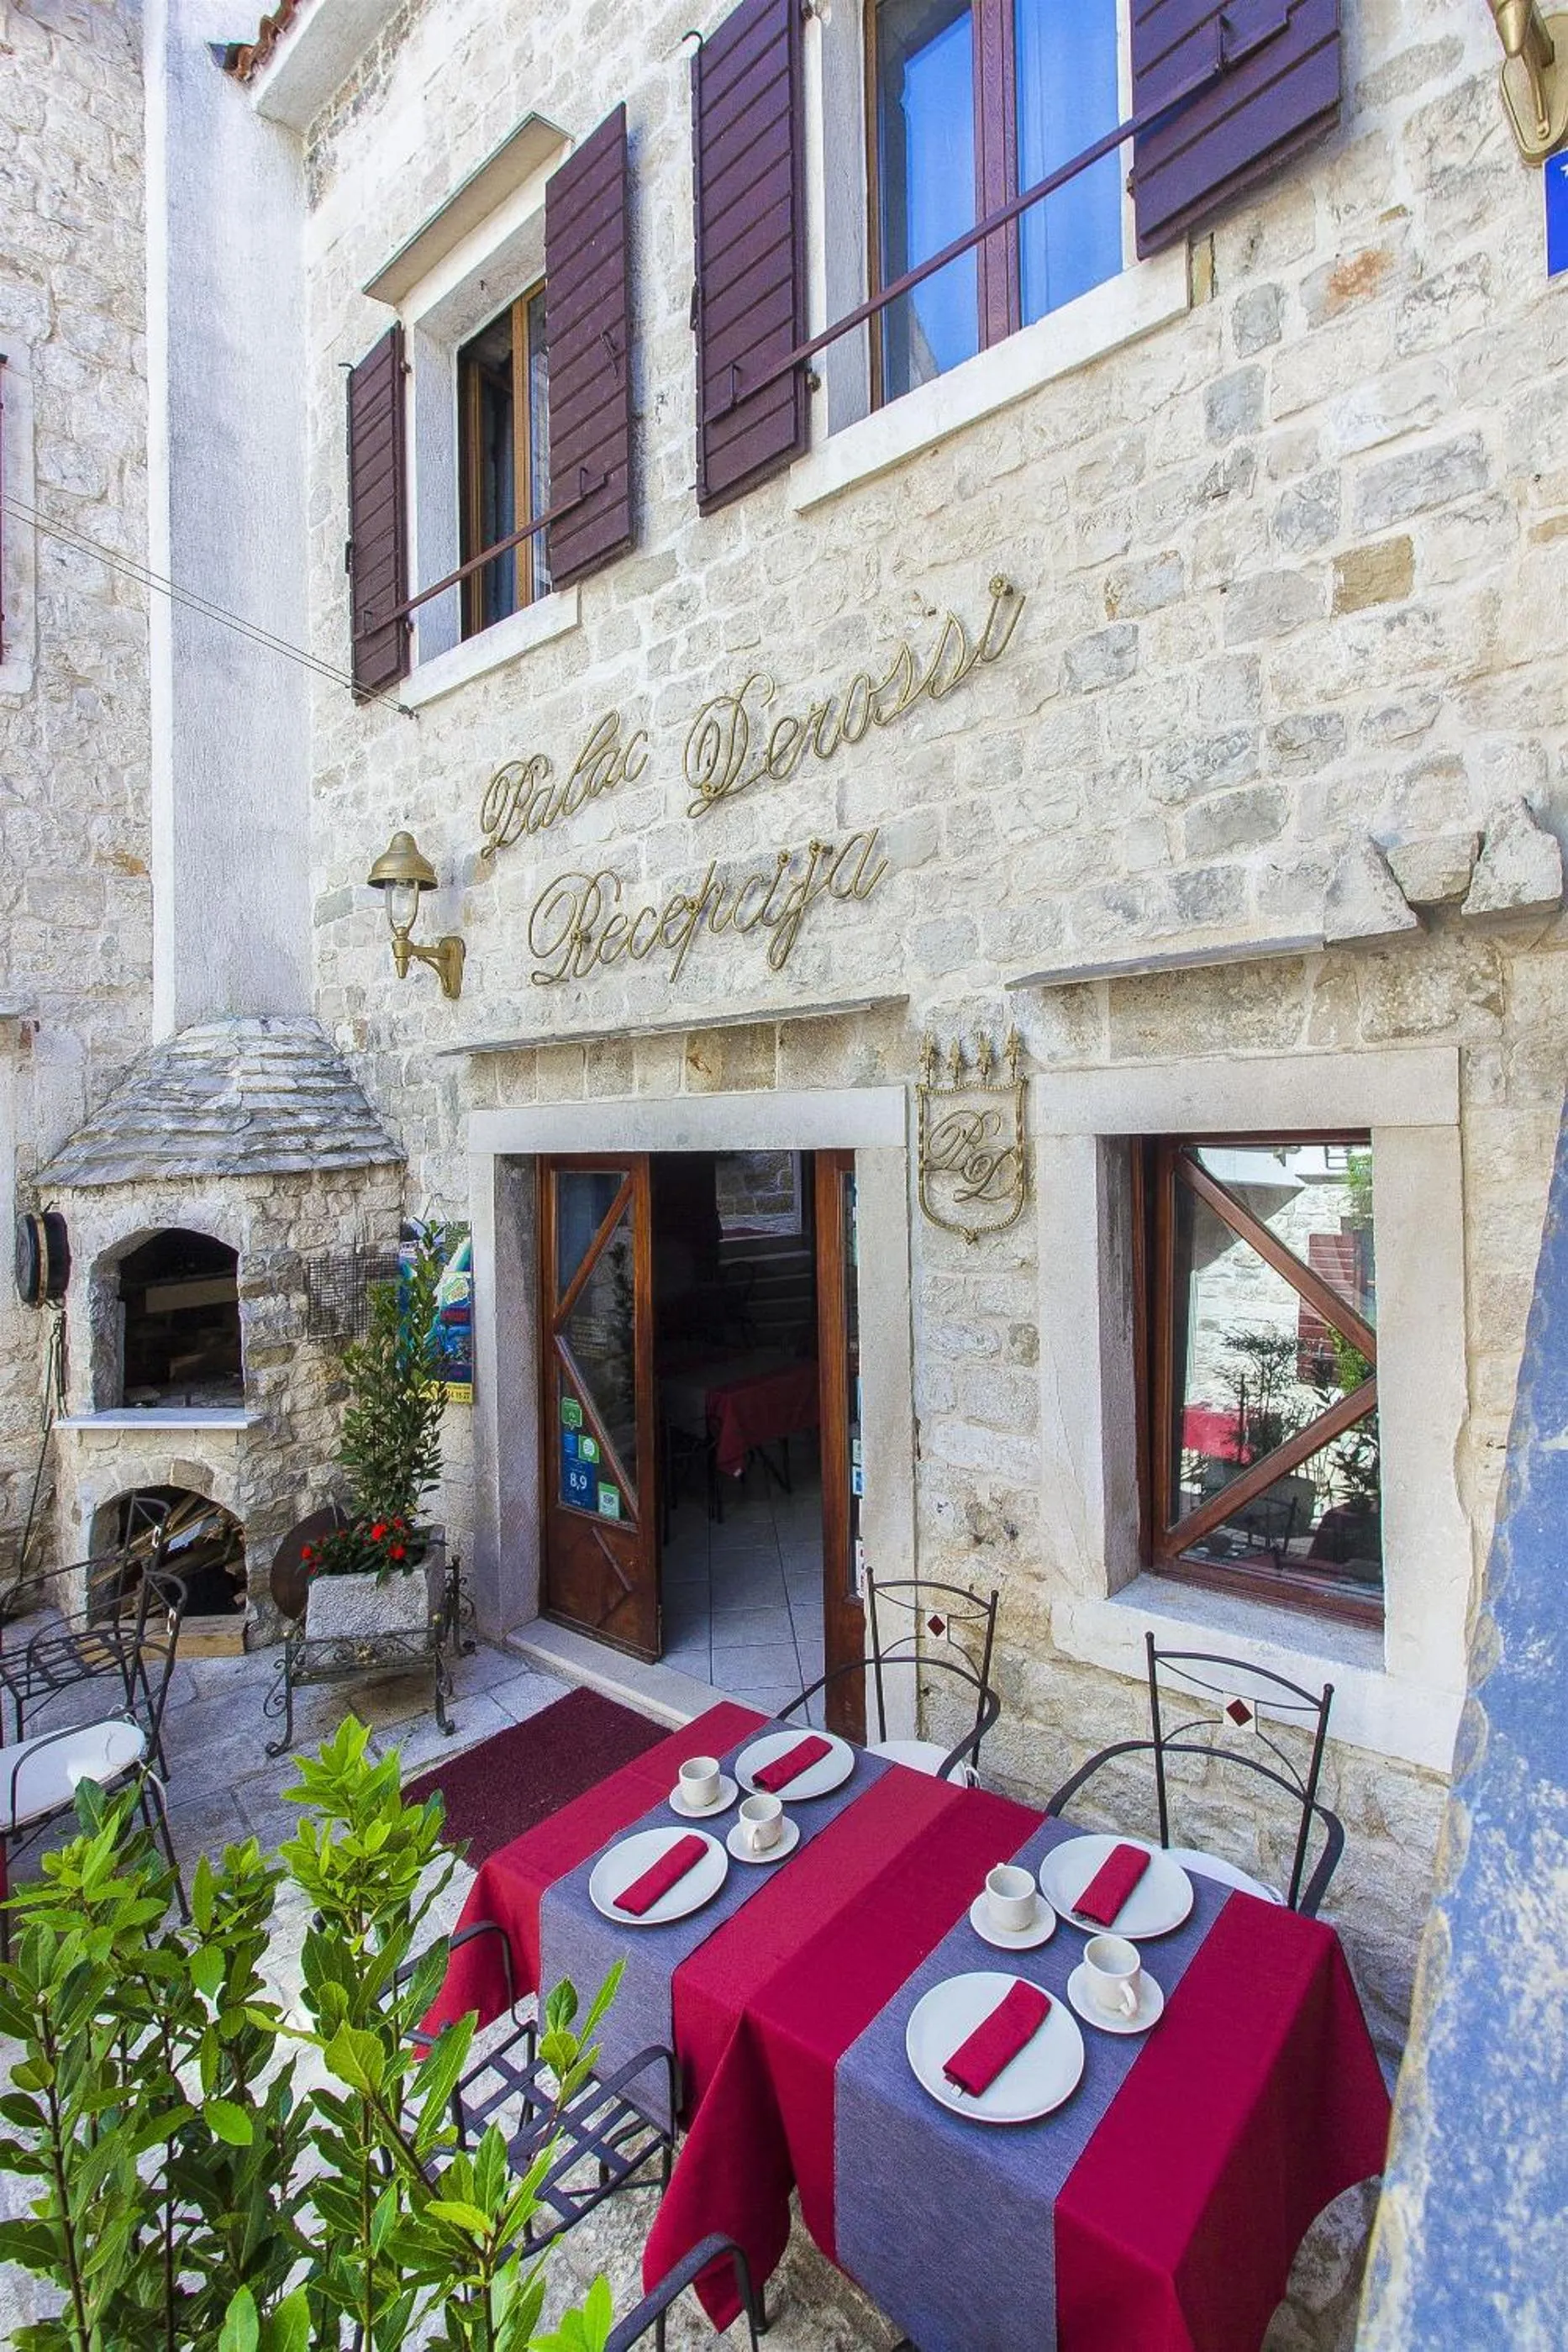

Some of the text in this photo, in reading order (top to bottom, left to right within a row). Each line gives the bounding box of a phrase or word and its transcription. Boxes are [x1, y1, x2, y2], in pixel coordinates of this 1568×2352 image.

[480, 574, 1025, 859] Palac Derossi
[527, 827, 889, 986] Recepcija
